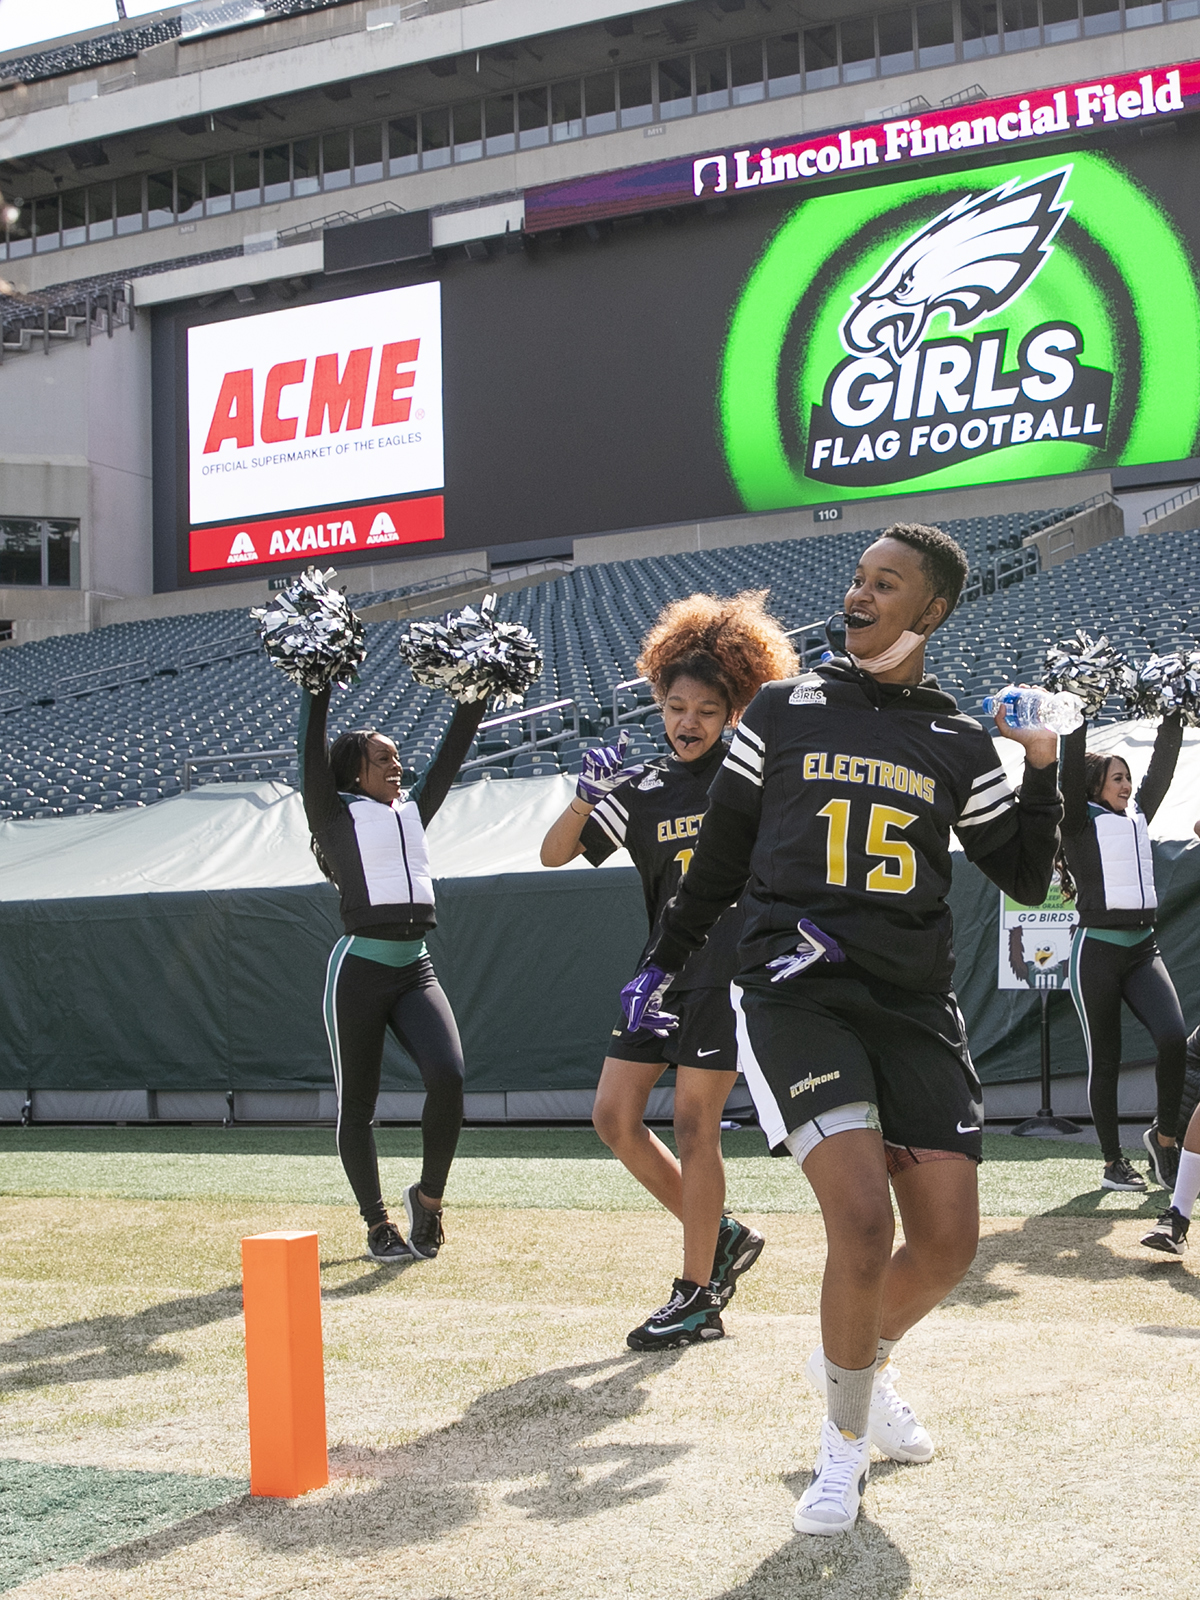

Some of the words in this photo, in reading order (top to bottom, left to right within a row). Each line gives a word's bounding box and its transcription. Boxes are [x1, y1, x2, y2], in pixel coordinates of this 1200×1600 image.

[734, 131, 879, 189] Lincoln
[883, 91, 1070, 161] Financial
[1075, 69, 1184, 127] Field
[830, 328, 1077, 427] GIRLS
[203, 337, 422, 455] ACME
[811, 430, 901, 469] FLAG
[909, 403, 1103, 456] FOOTBALL
[201, 459, 249, 476] OFFICIAL
[251, 446, 332, 468] SUPERMARKET
[335, 443, 350, 455] OF
[354, 438, 375, 451] THE
[378, 432, 422, 448] EAGLES
[817, 508, 838, 520] 110
[269, 520, 357, 555] AXALTA
[366, 532, 399, 545] AXALTA
[227, 552, 259, 563] AXALTA
[273, 578, 287, 588] 111
[792, 691, 823, 700] GIRLS
[803, 752, 936, 805] ELECTRONS
[657, 813, 705, 843] ELECT
[815, 798, 920, 895] 15
[1018, 913, 1037, 923] GO
[1039, 912, 1075, 923] BIRDS
